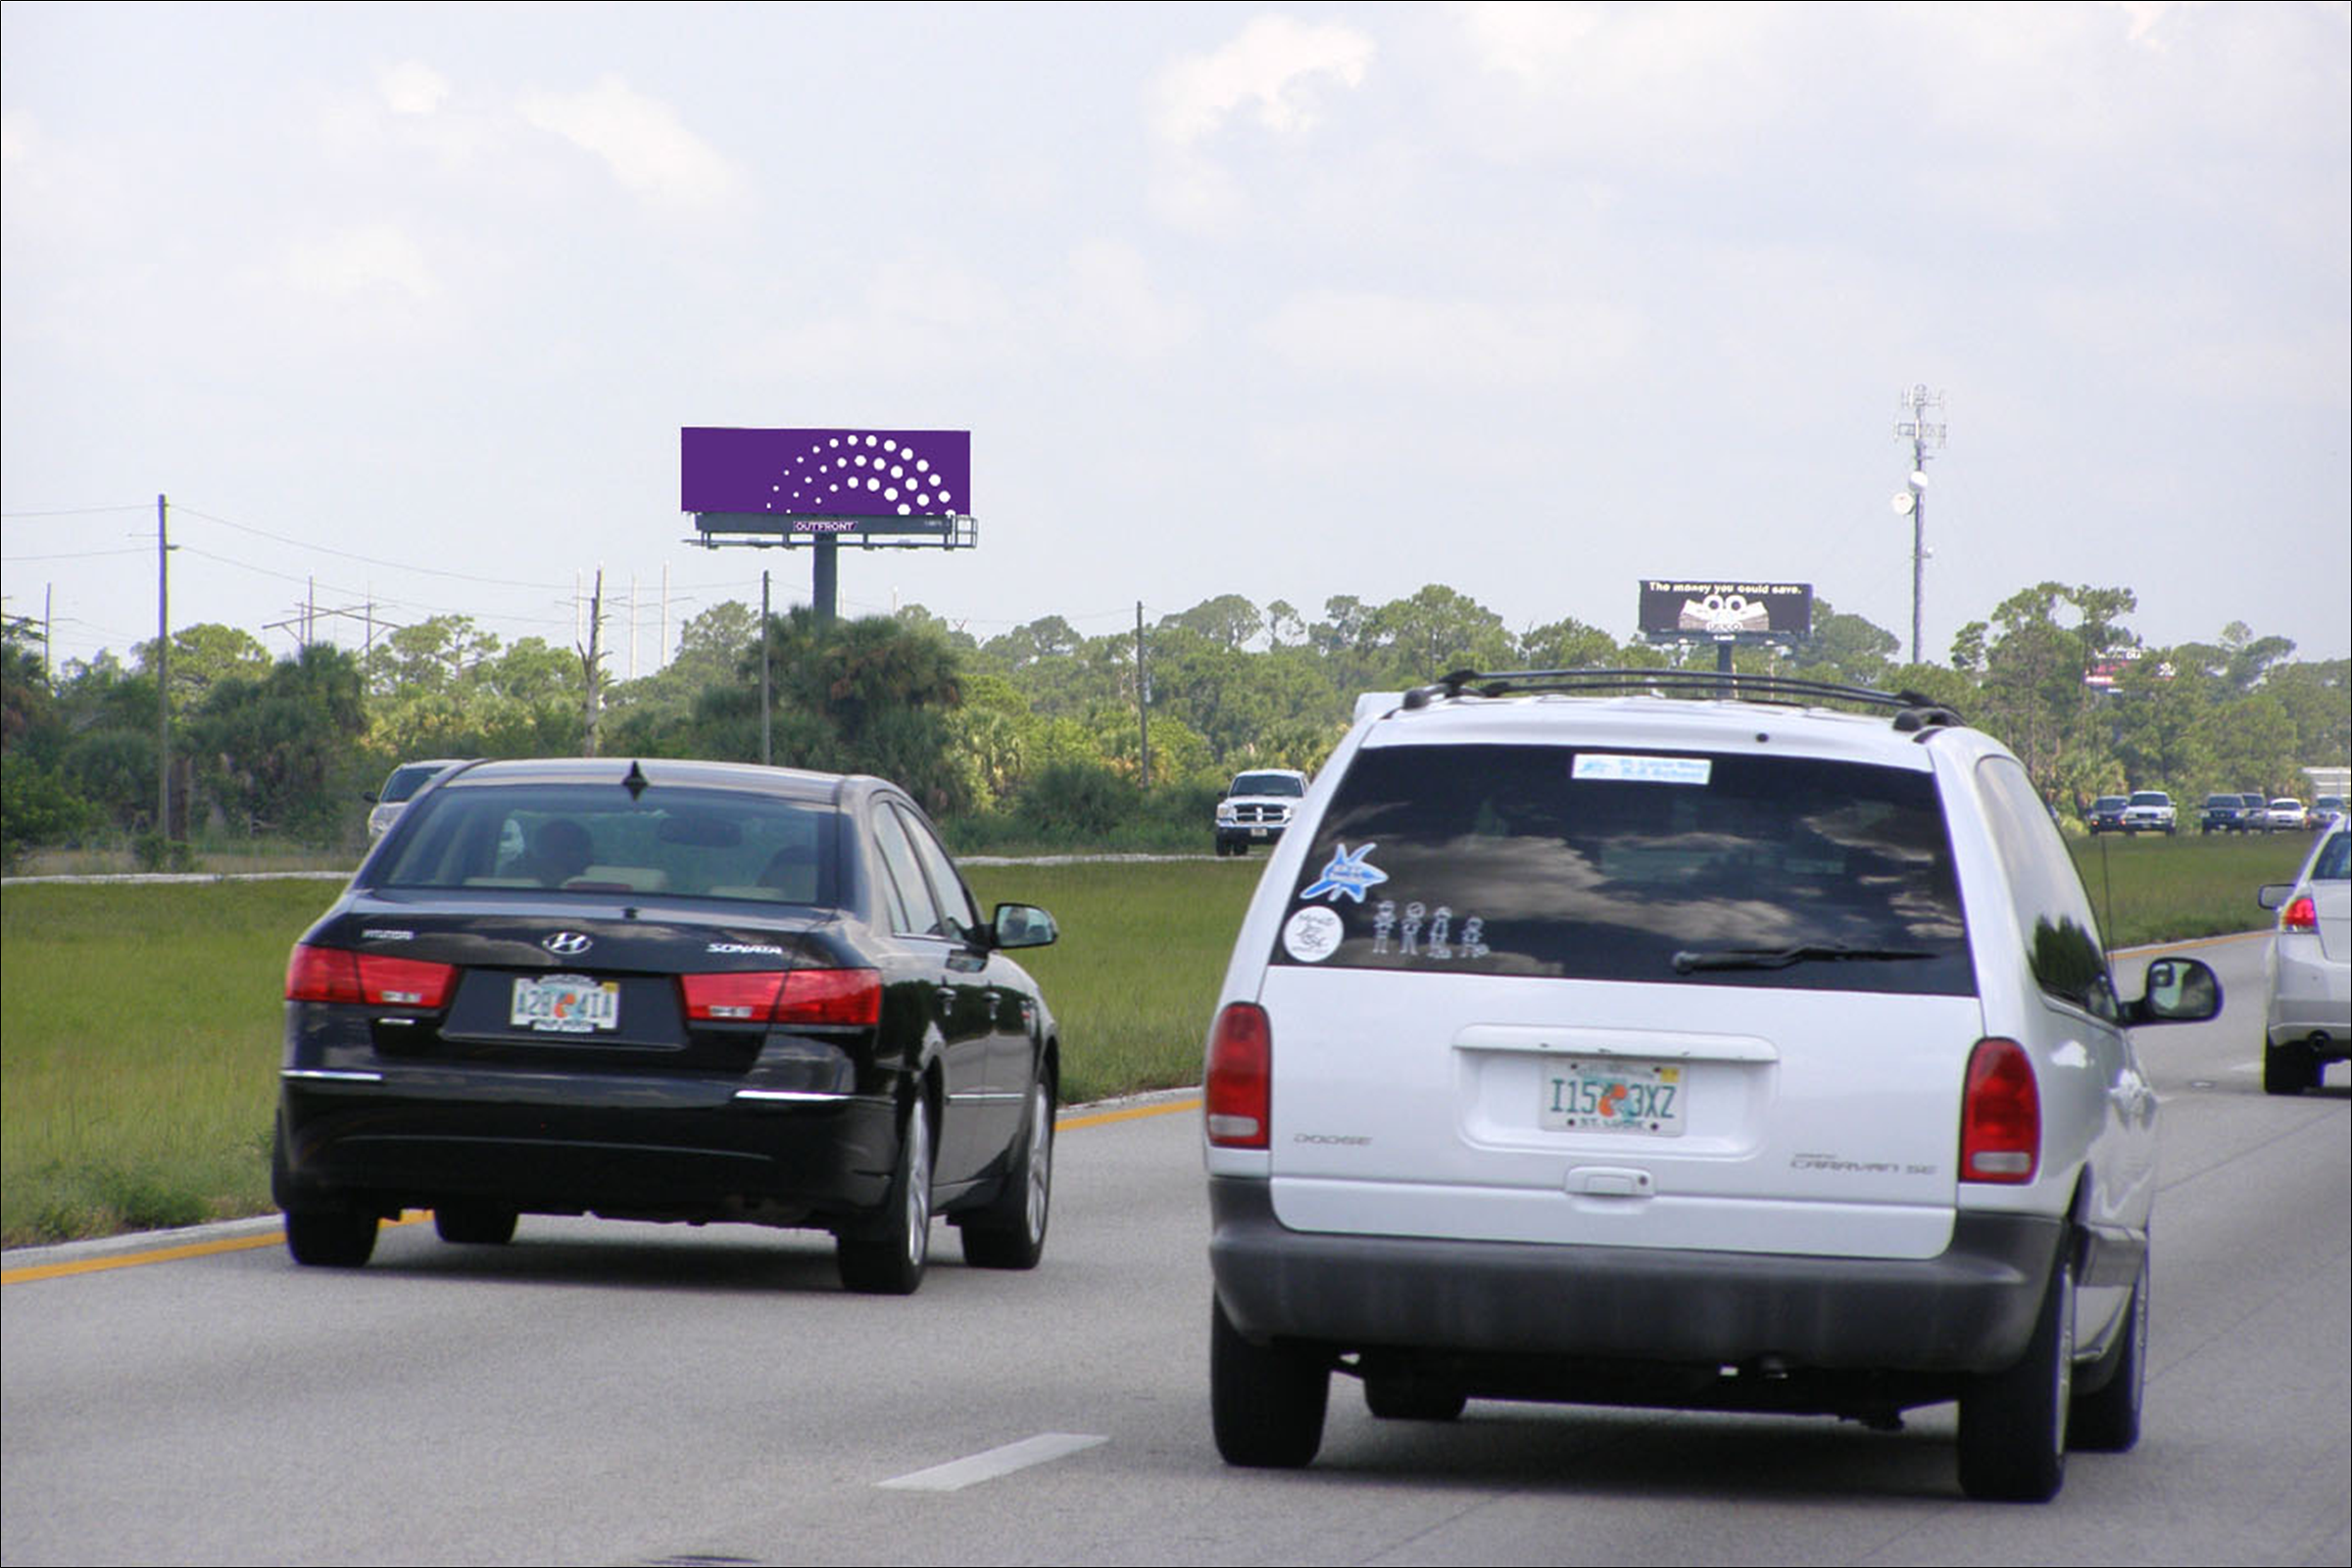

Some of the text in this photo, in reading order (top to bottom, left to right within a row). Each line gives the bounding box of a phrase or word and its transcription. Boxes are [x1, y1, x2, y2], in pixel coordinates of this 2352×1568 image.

[795, 520, 855, 531] OUTFRONT
[1649, 581, 1670, 591] The
[1673, 583, 1711, 594] money
[1714, 584, 1734, 594] you
[1738, 584, 1769, 594] could
[706, 943, 782, 954] SONATA
